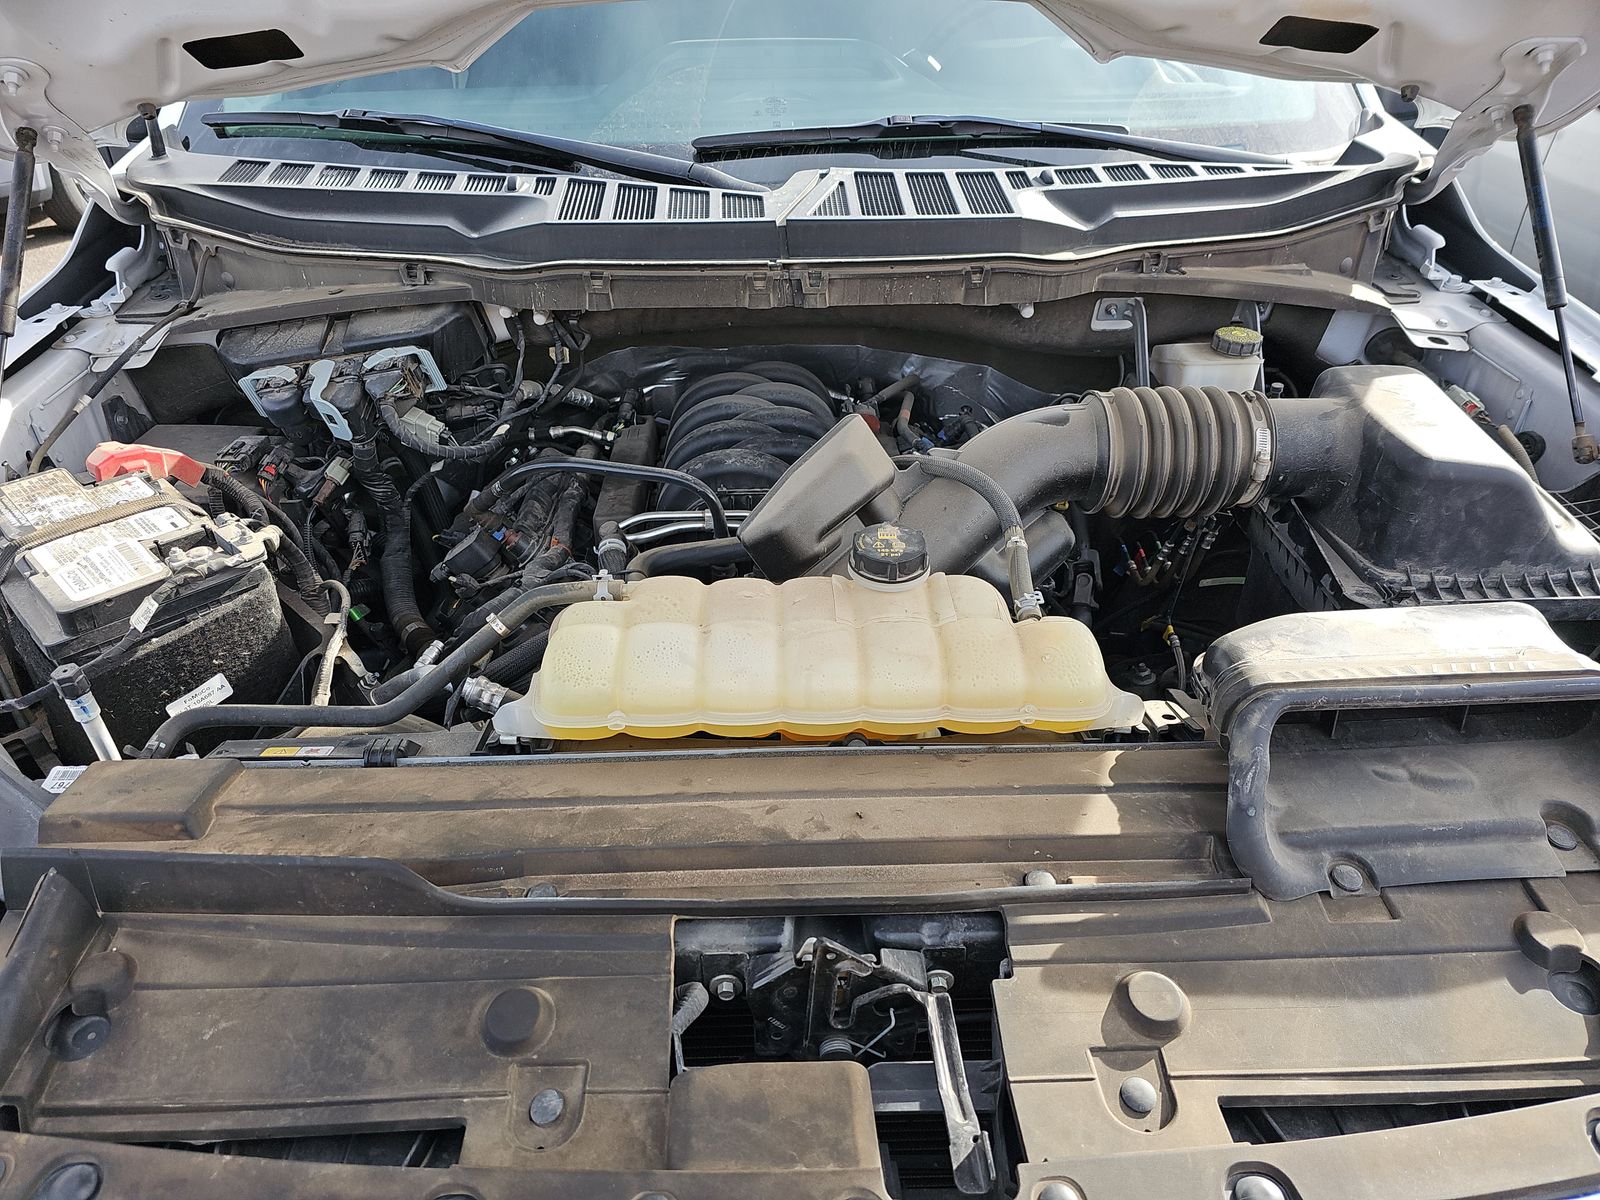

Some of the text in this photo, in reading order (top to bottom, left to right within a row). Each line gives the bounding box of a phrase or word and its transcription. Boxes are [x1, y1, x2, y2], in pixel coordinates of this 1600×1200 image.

[183, 686, 210, 704] FoMoCo
[193, 690, 215, 706] 10A687
[216, 684, 226, 692] AA
